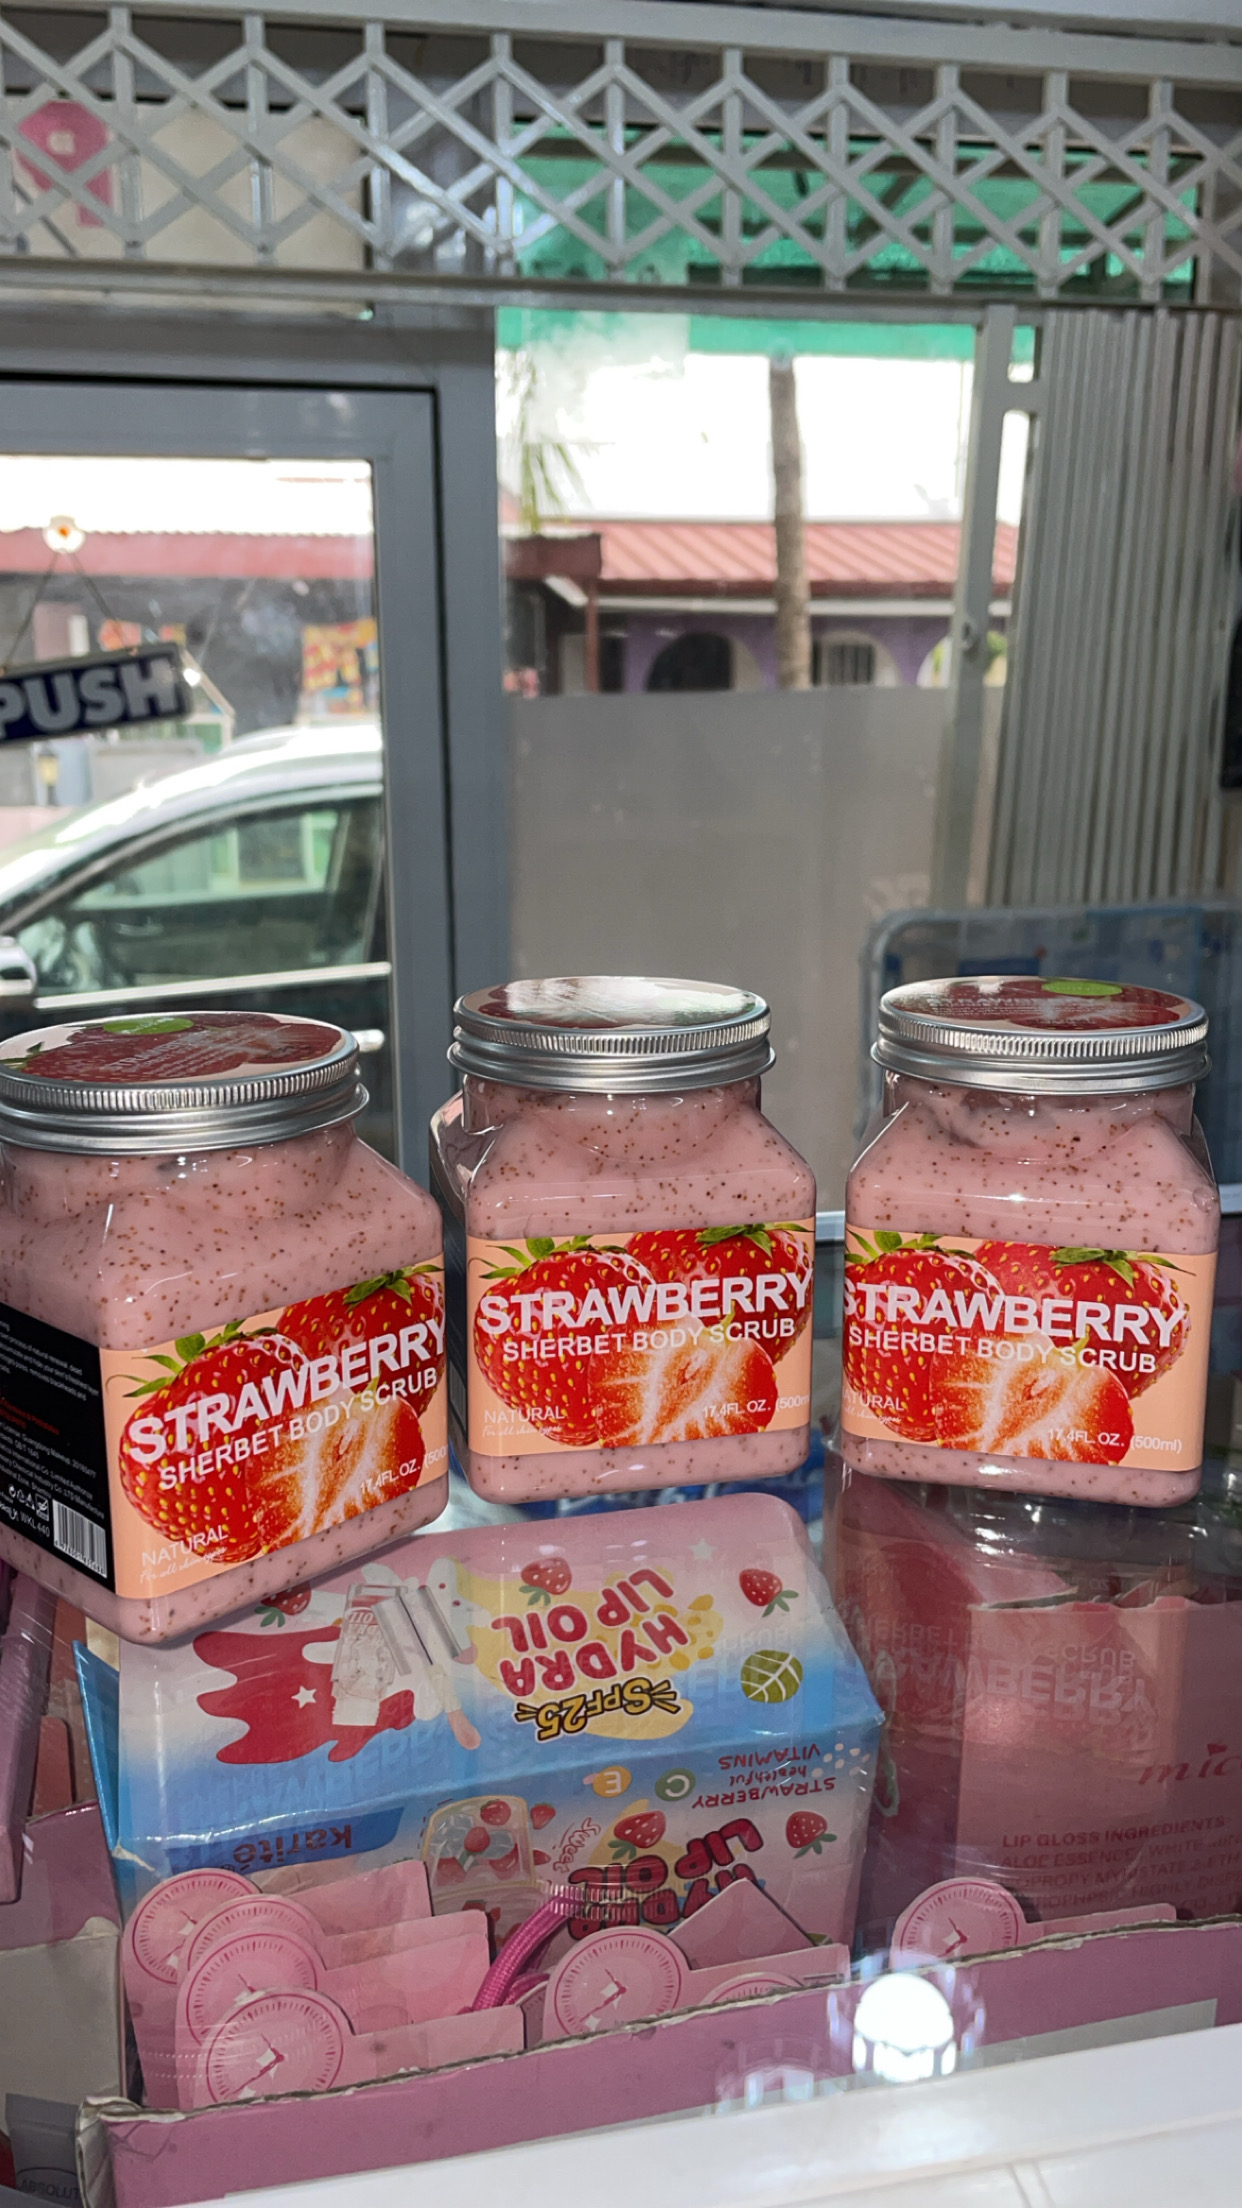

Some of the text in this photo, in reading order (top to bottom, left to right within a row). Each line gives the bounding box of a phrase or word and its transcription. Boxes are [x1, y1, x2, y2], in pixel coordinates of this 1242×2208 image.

[0, 658, 176, 739] PUSH
[479, 1268, 813, 1335] STRAWBERRY
[844, 1276, 1186, 1348] STRAWBERRY
[503, 1317, 795, 1361] SHERBET BODY SCRUB
[849, 1325, 1156, 1373] SHERBET BODY SCRUB
[128, 1319, 445, 1464] STRAWBERRY
[843, 1388, 905, 1411] ATURAL
[160, 1367, 438, 1490] SHERBET BODY SCRUB
[484, 1405, 565, 1424] NATURAL
[424, 1444, 448, 1469] (500
[1131, 1435, 1182, 1454] (500ml)
[142, 1525, 229, 1567] NATURAL
[491, 1569, 674, 1652] LIP OIL
[500, 1614, 689, 1697] HYDRA
[535, 1676, 652, 1741] SPF25
[718, 1744, 821, 1770] VITAMINS
[729, 1765, 807, 1787] healthful
[1138, 1743, 1242, 1785] mic
[604, 1771, 622, 1793] E
[665, 1775, 690, 1797] C
[692, 1777, 837, 1809] STRAWBERRY
[233, 1824, 352, 1871] karité
[568, 1818, 763, 1902] LIP OIL
[1003, 1835, 1031, 1848] LIP
[1037, 1831, 1099, 1847] GLOSS
